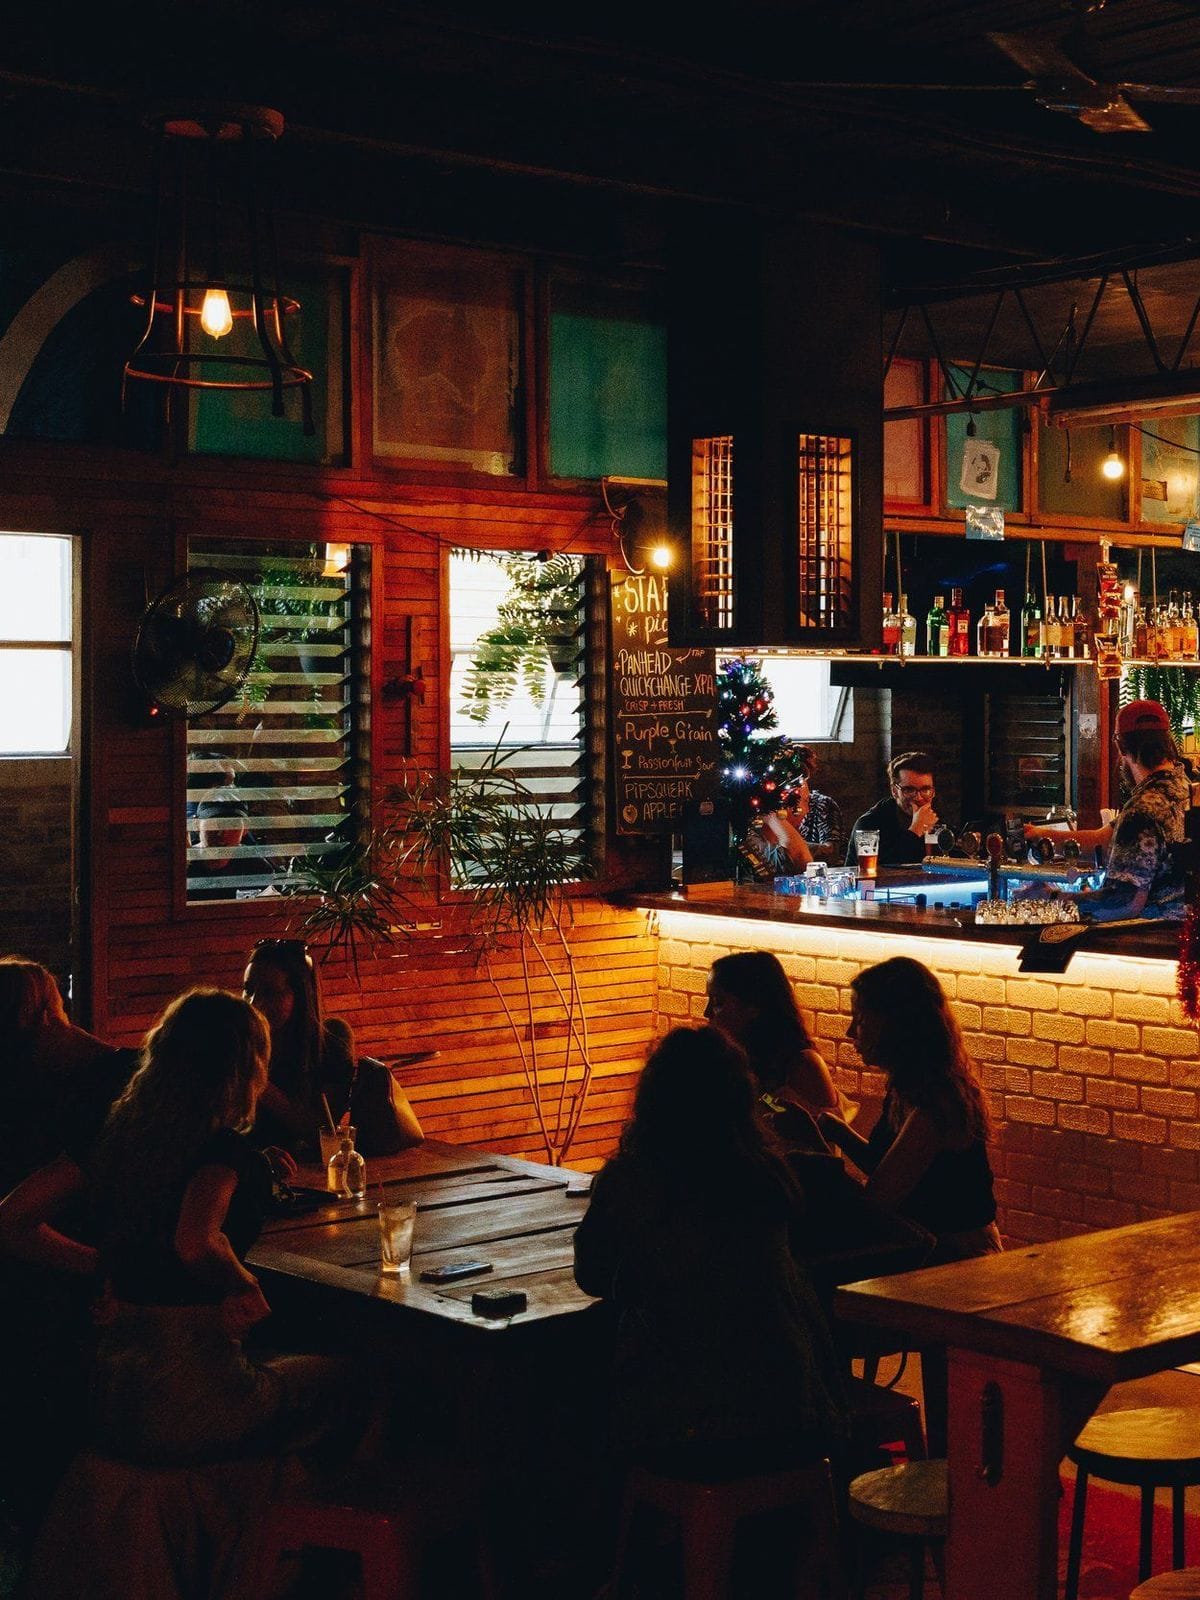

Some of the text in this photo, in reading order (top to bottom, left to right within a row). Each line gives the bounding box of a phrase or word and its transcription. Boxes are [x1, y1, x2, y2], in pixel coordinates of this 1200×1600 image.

[618, 648, 672, 676] PANHEAD
[693, 673, 714, 696] XPA
[658, 700, 685, 711] FRESH
[625, 720, 670, 751] Purple
